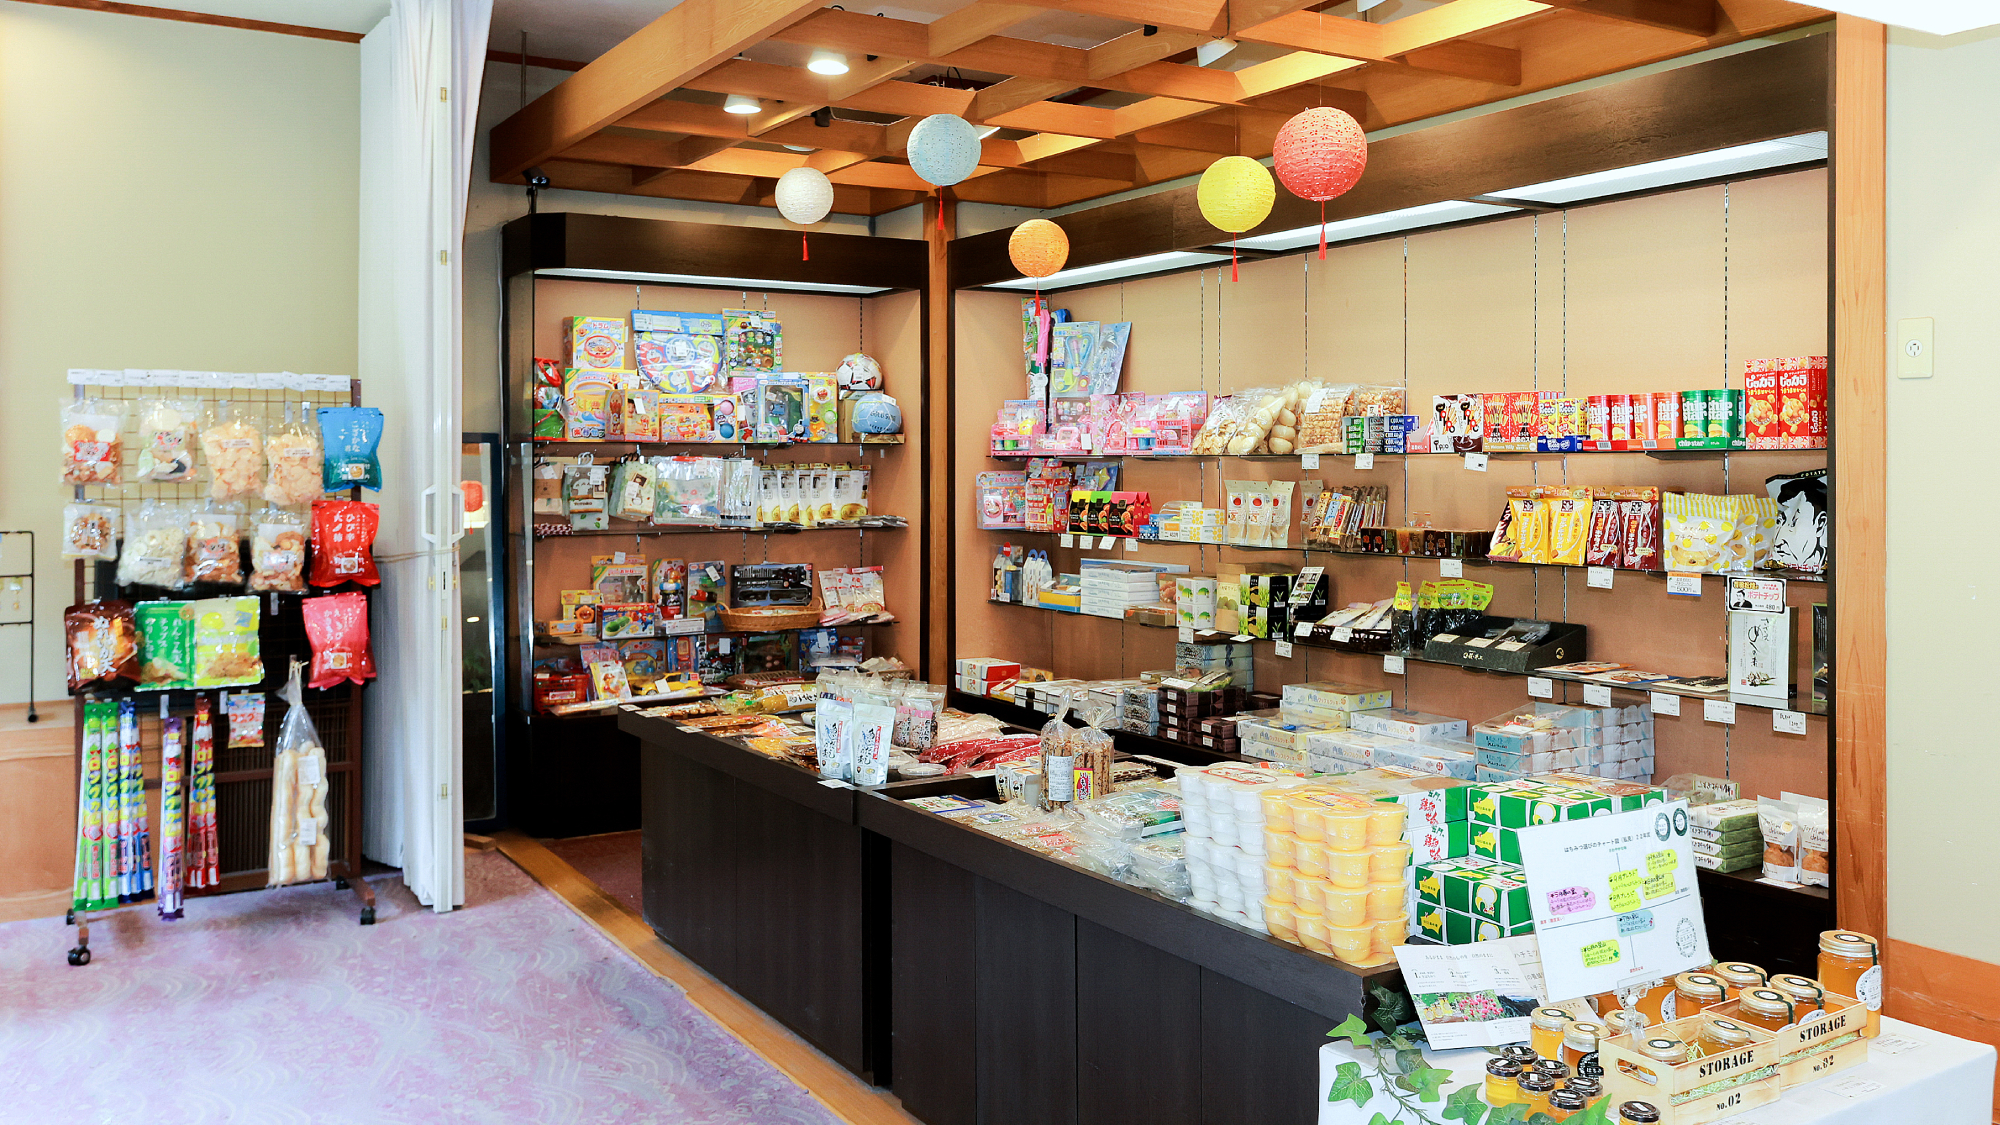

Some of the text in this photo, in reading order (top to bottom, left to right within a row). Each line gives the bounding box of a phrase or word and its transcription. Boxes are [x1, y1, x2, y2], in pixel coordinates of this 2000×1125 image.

[1748, 591, 1780, 600] ポテトチップ
[1799, 1014, 1847, 1043] STORAGE
[1699, 1050, 1754, 1078] STORAGE
